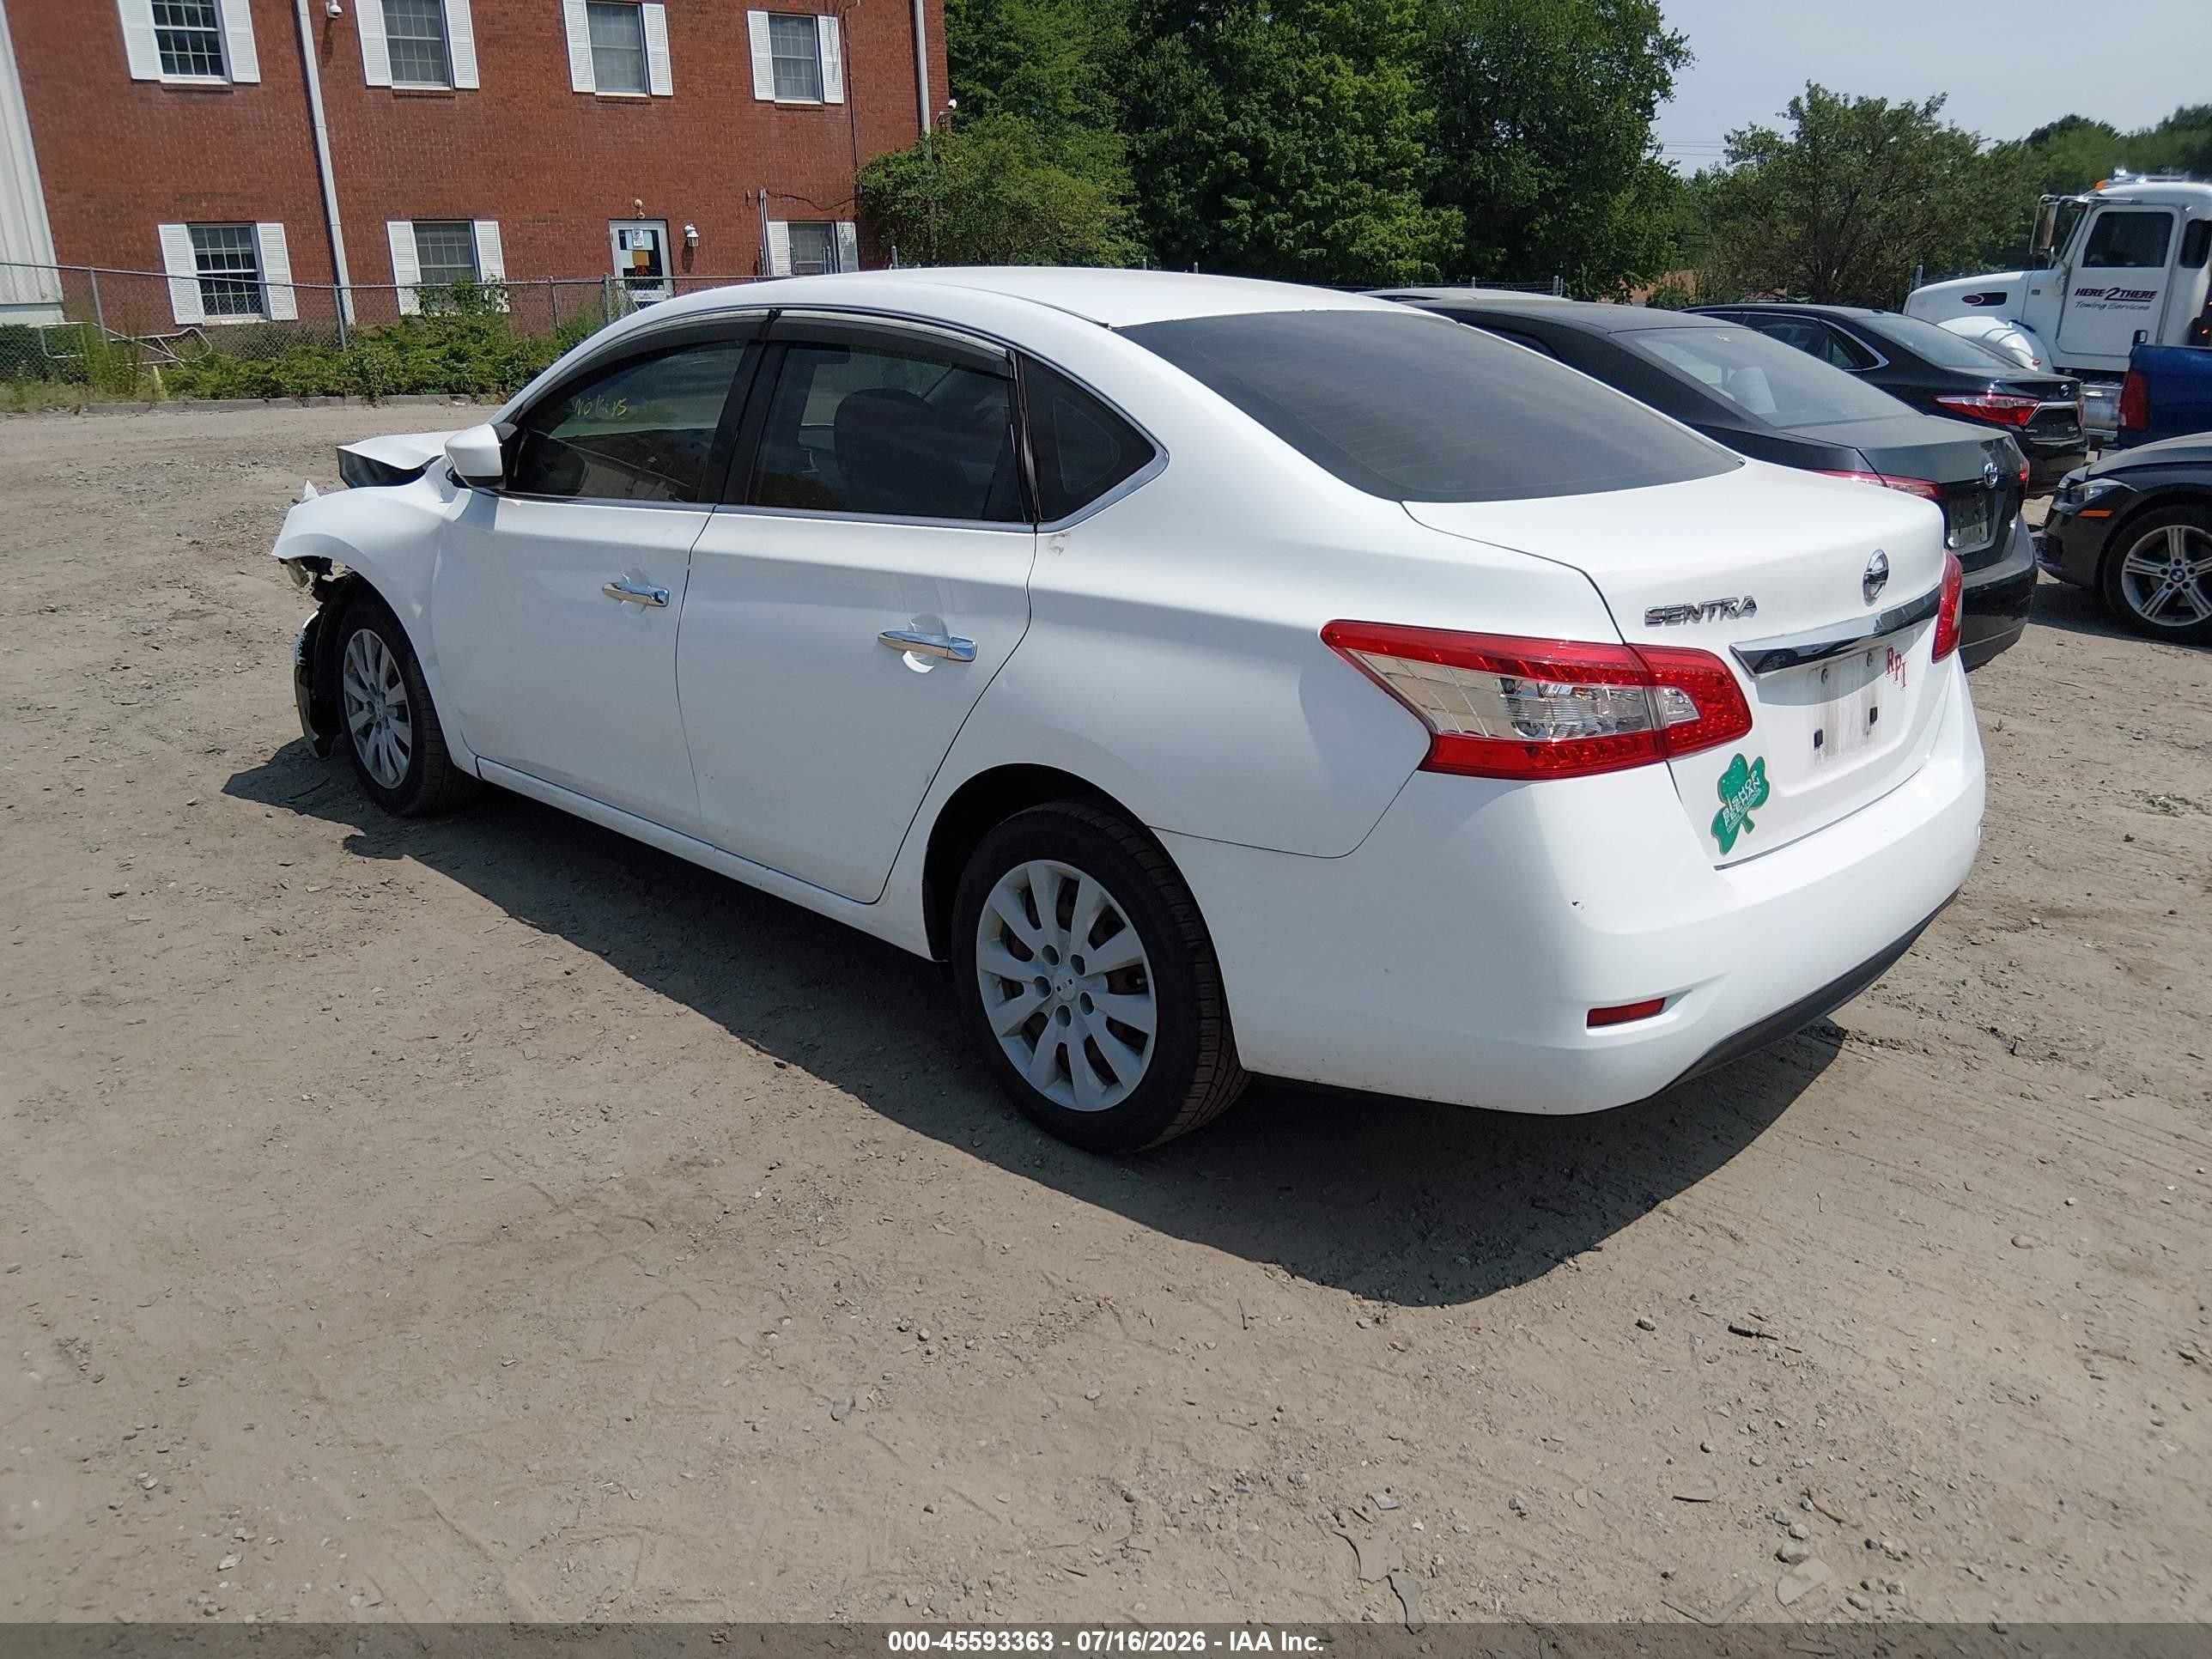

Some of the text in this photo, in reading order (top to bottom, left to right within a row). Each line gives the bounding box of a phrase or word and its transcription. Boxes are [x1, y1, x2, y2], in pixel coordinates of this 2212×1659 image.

[2075, 301, 2150, 311] Towing Services
[1644, 595, 1758, 628] SENTRA
[1886, 646, 1907, 690] RPI
[1723, 770, 1758, 819] BISHOP
